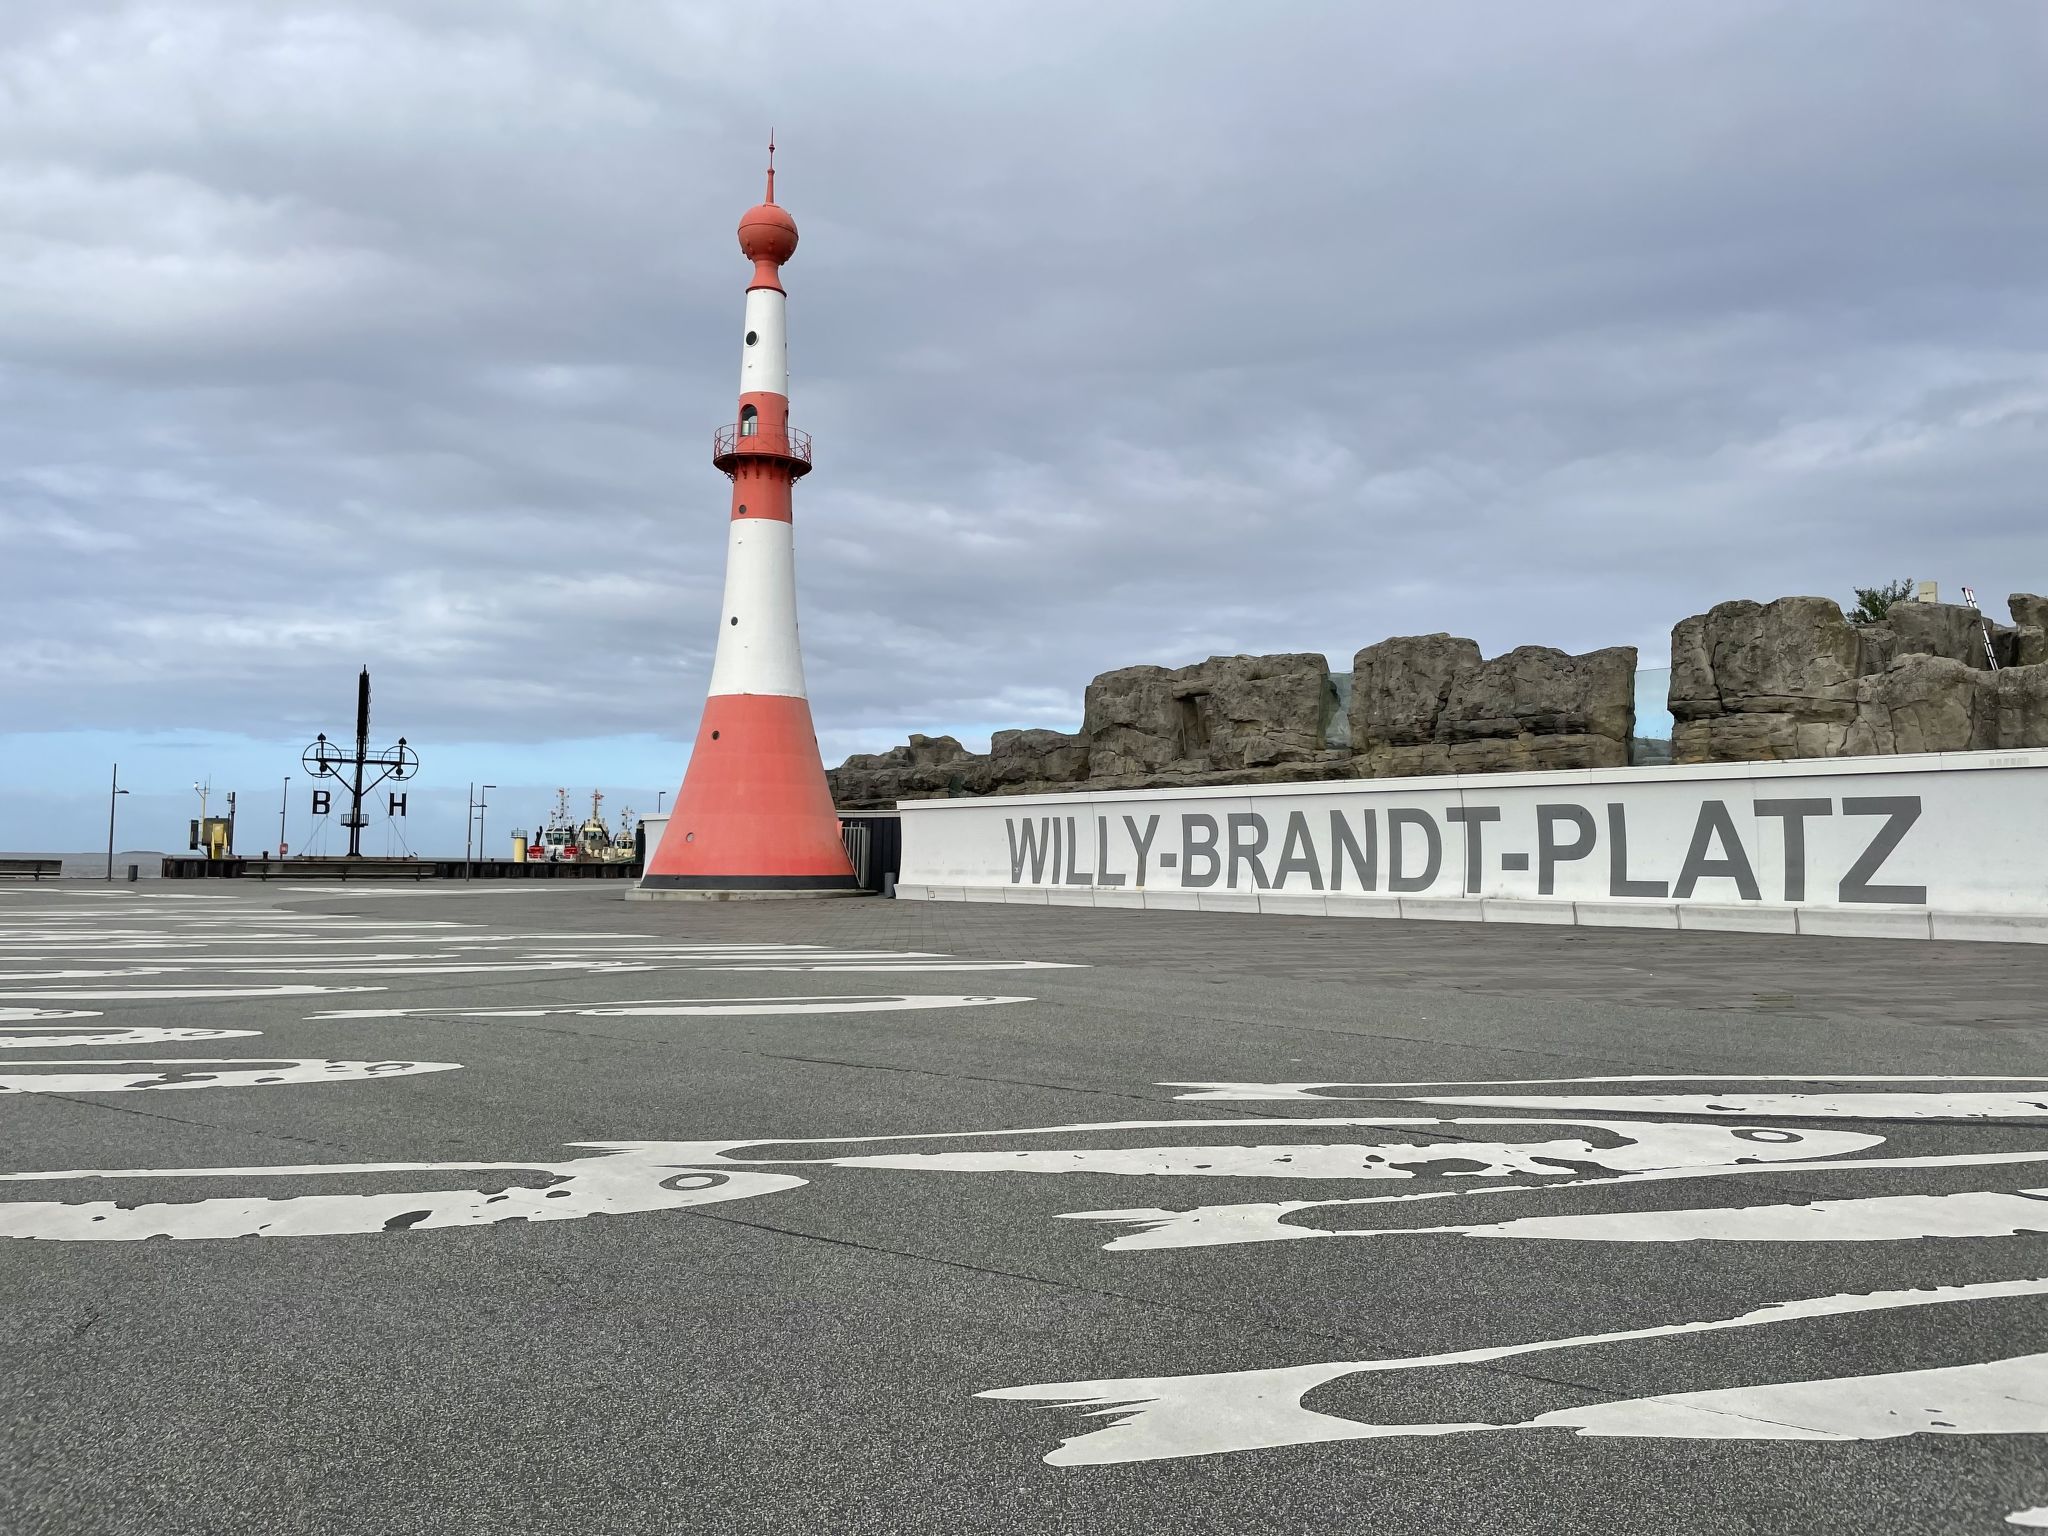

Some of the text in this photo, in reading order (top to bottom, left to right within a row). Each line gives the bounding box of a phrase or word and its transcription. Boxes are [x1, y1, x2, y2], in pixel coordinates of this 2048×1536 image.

[312, 790, 331, 815] B
[389, 792, 407, 817] H
[1005, 796, 1927, 904] WILLY-BRANDT-PLATZ
